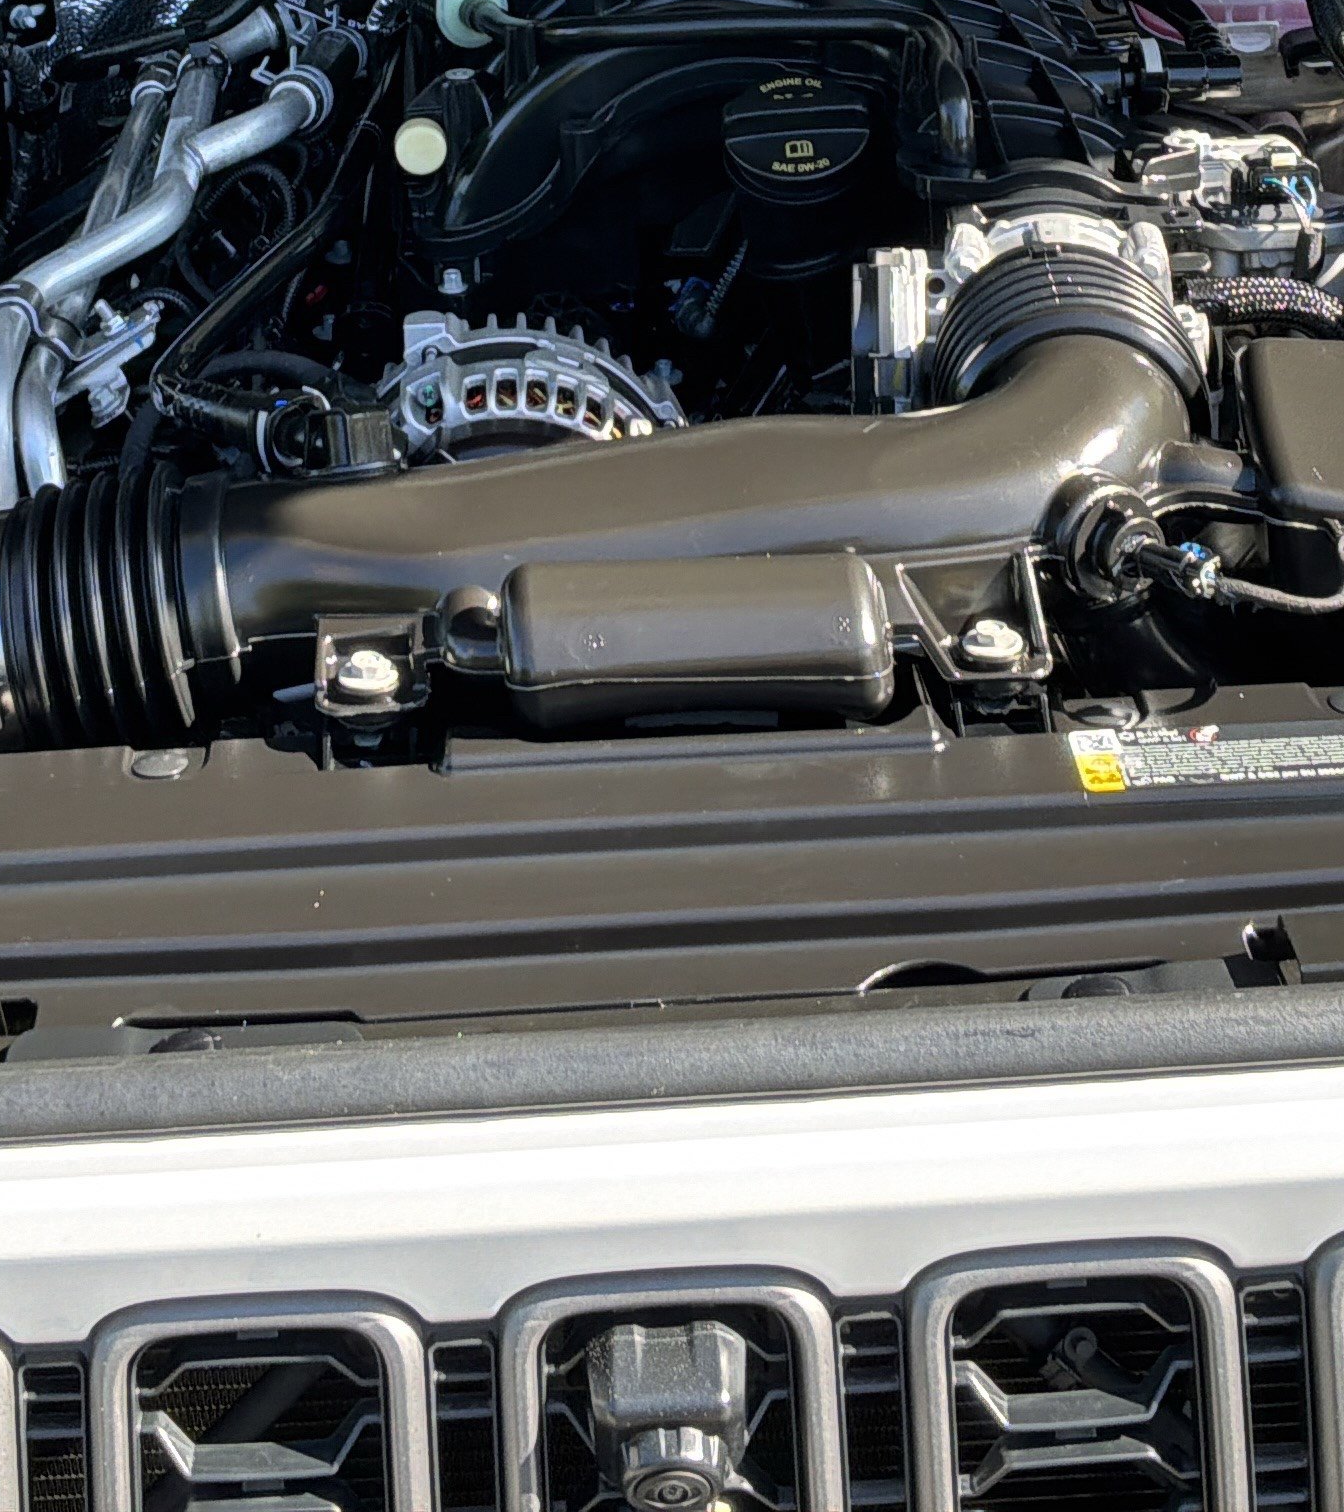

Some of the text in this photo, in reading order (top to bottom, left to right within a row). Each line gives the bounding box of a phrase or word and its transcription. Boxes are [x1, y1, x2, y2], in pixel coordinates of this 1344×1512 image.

[759, 77, 823, 93] ENGINE OIL
[771, 157, 831, 173] SAE 0W-20
